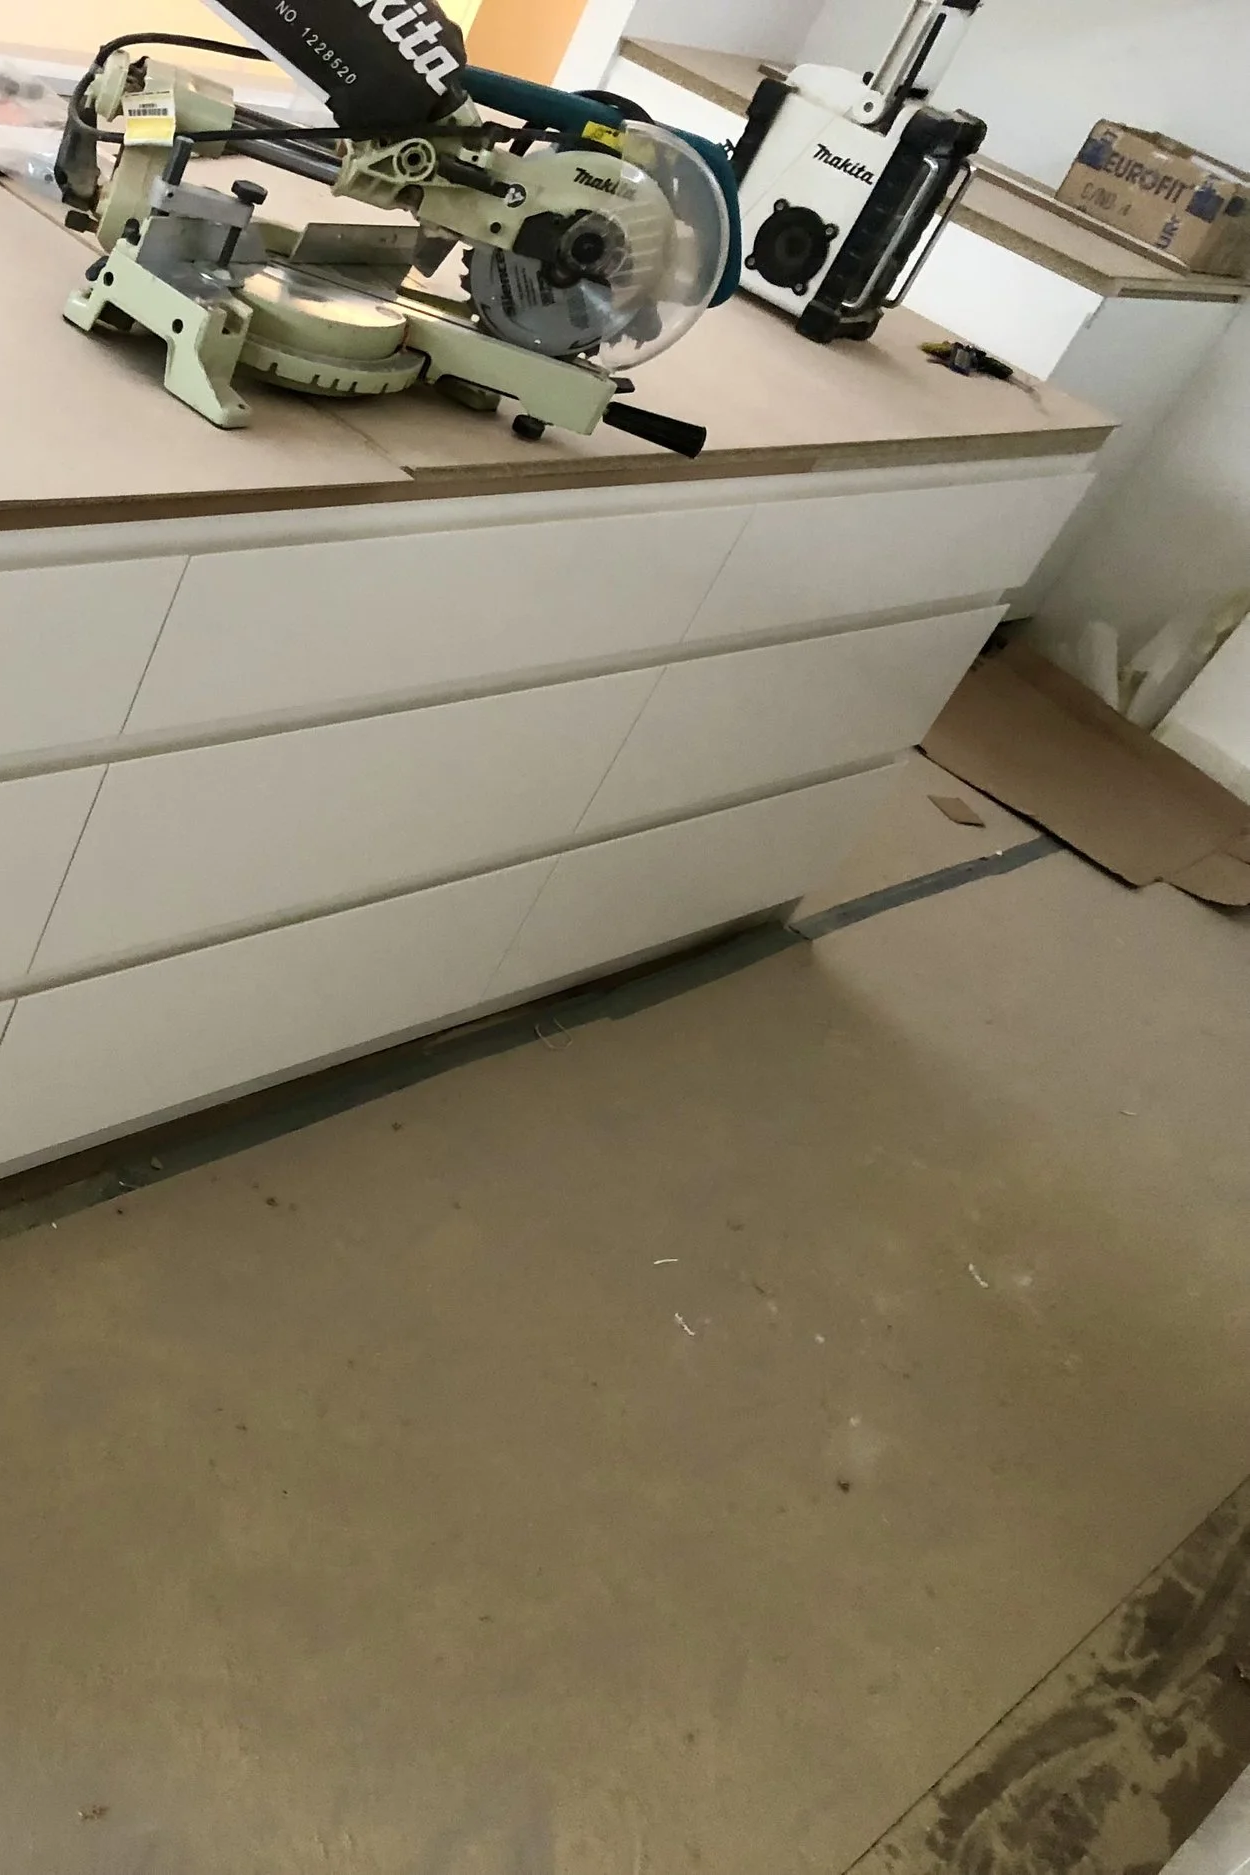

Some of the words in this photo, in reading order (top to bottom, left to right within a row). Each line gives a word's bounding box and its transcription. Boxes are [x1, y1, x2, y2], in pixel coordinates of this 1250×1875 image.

[301, 27, 357, 85] 1228520
[354, 0, 459, 96] kita
[1104, 152, 1194, 203] EUROFIT
